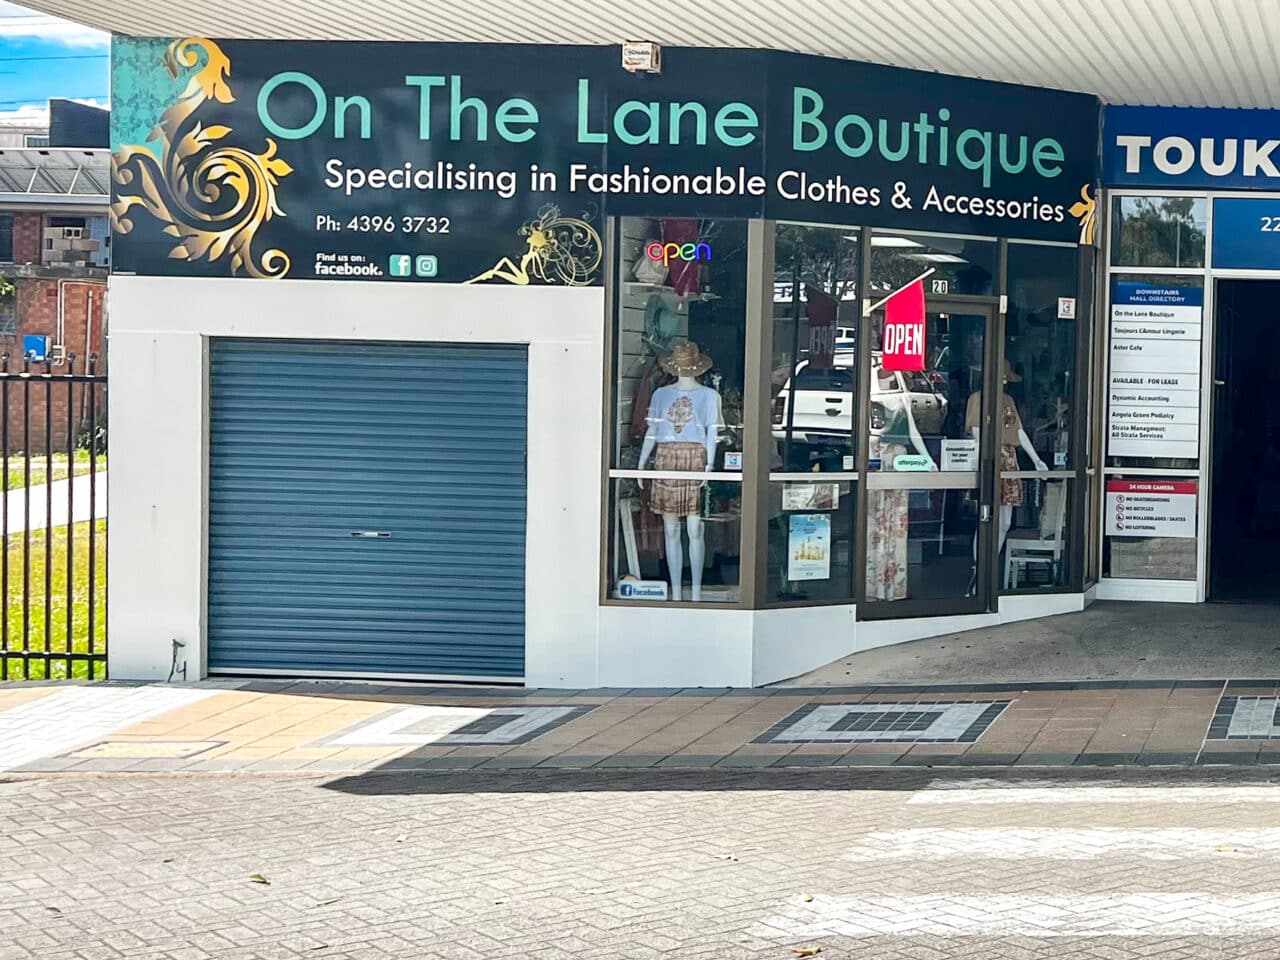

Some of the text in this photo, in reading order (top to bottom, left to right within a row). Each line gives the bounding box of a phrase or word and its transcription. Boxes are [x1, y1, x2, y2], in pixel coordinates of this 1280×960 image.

[256, 71, 1065, 188] On The Lane Boutique
[324, 159, 1065, 222] Specialising in Fashionable Clothes & Accessories
[315, 214, 450, 233] Ph: 4396 3732
[315, 252, 366, 262] Find us on:
[647, 241, 712, 267] open
[934, 280, 947, 293] 20
[884, 323, 923, 356] OPEN
[1112, 377, 1144, 385] AVAILABLE
[1112, 394, 1170, 403] Dynamic Accounting
[633, 588, 665, 597] facebook
